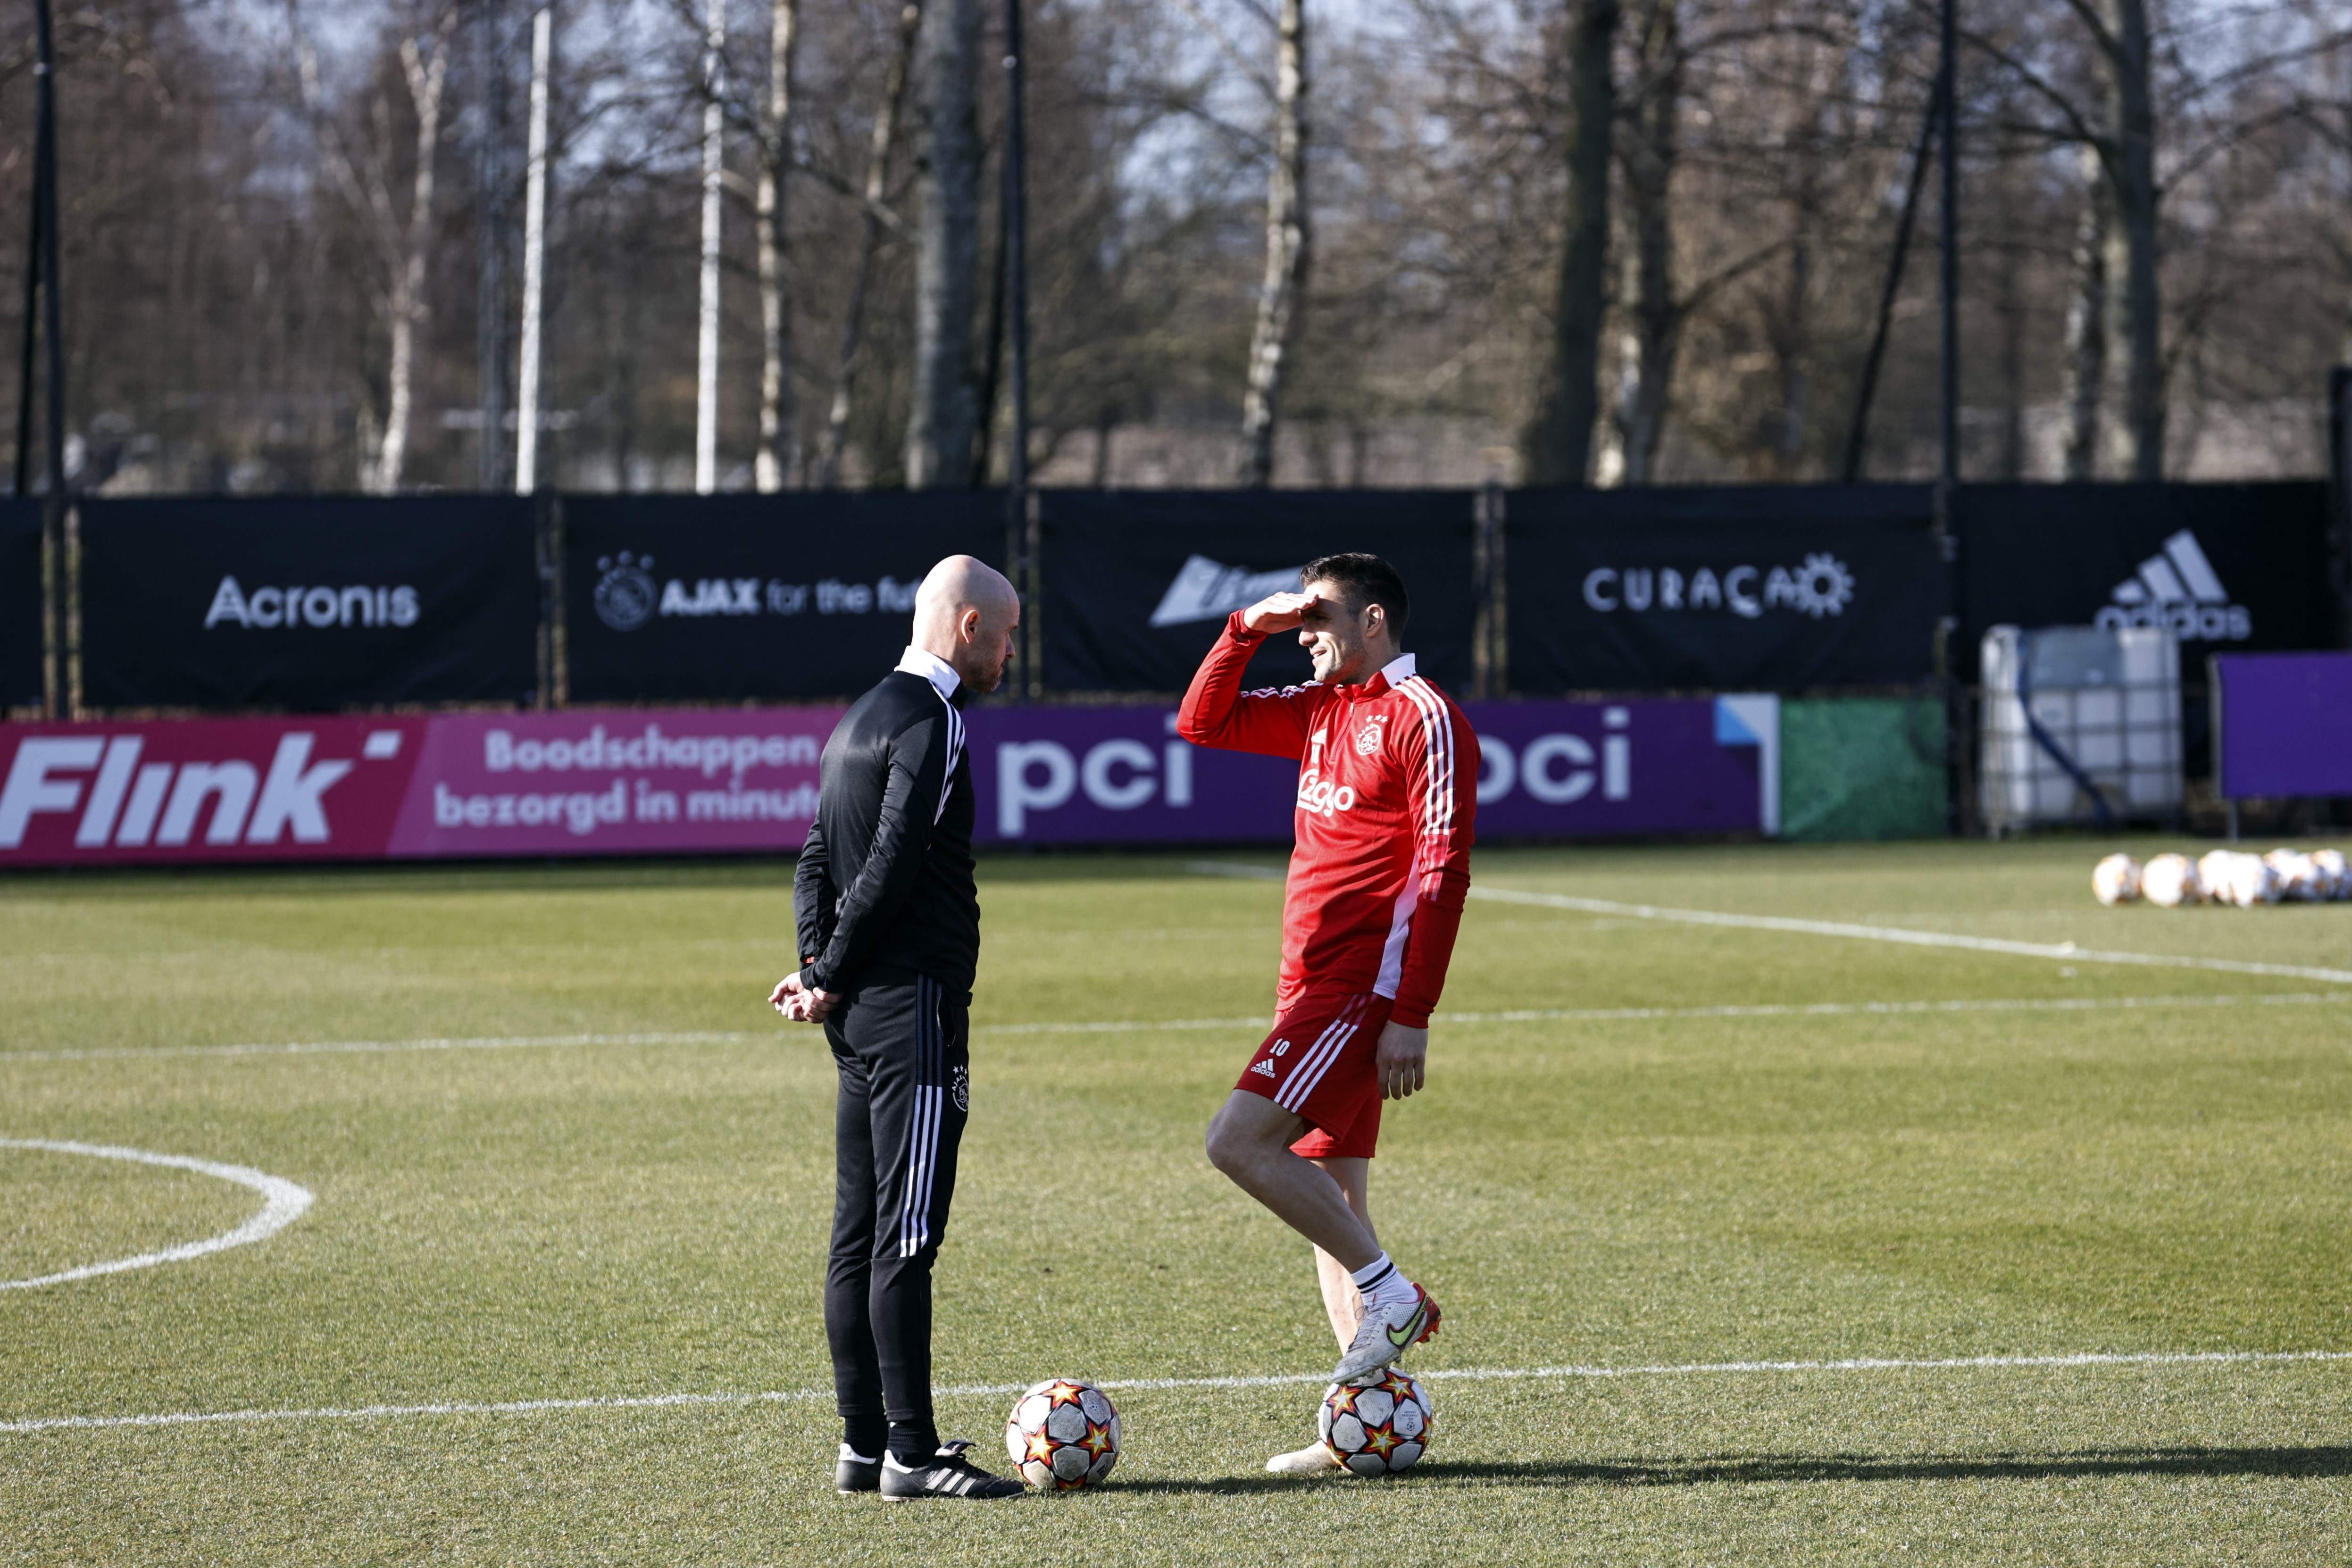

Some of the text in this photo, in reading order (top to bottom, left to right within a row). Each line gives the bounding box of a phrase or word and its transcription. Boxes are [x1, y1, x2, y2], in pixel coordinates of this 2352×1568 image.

[205, 575, 420, 629] Acronis
[660, 578, 760, 615] AJAX
[767, 578, 806, 613] for
[817, 577, 872, 613] the
[2093, 605, 2252, 640] adidas
[485, 723, 818, 778] Boodschappen
[996, 712, 1193, 838] pci
[0, 733, 354, 848] Flink
[434, 774, 820, 836] bezorgd in minut
[1251, 1066, 1276, 1078] adidas
[1269, 1038, 1290, 1057] 10
